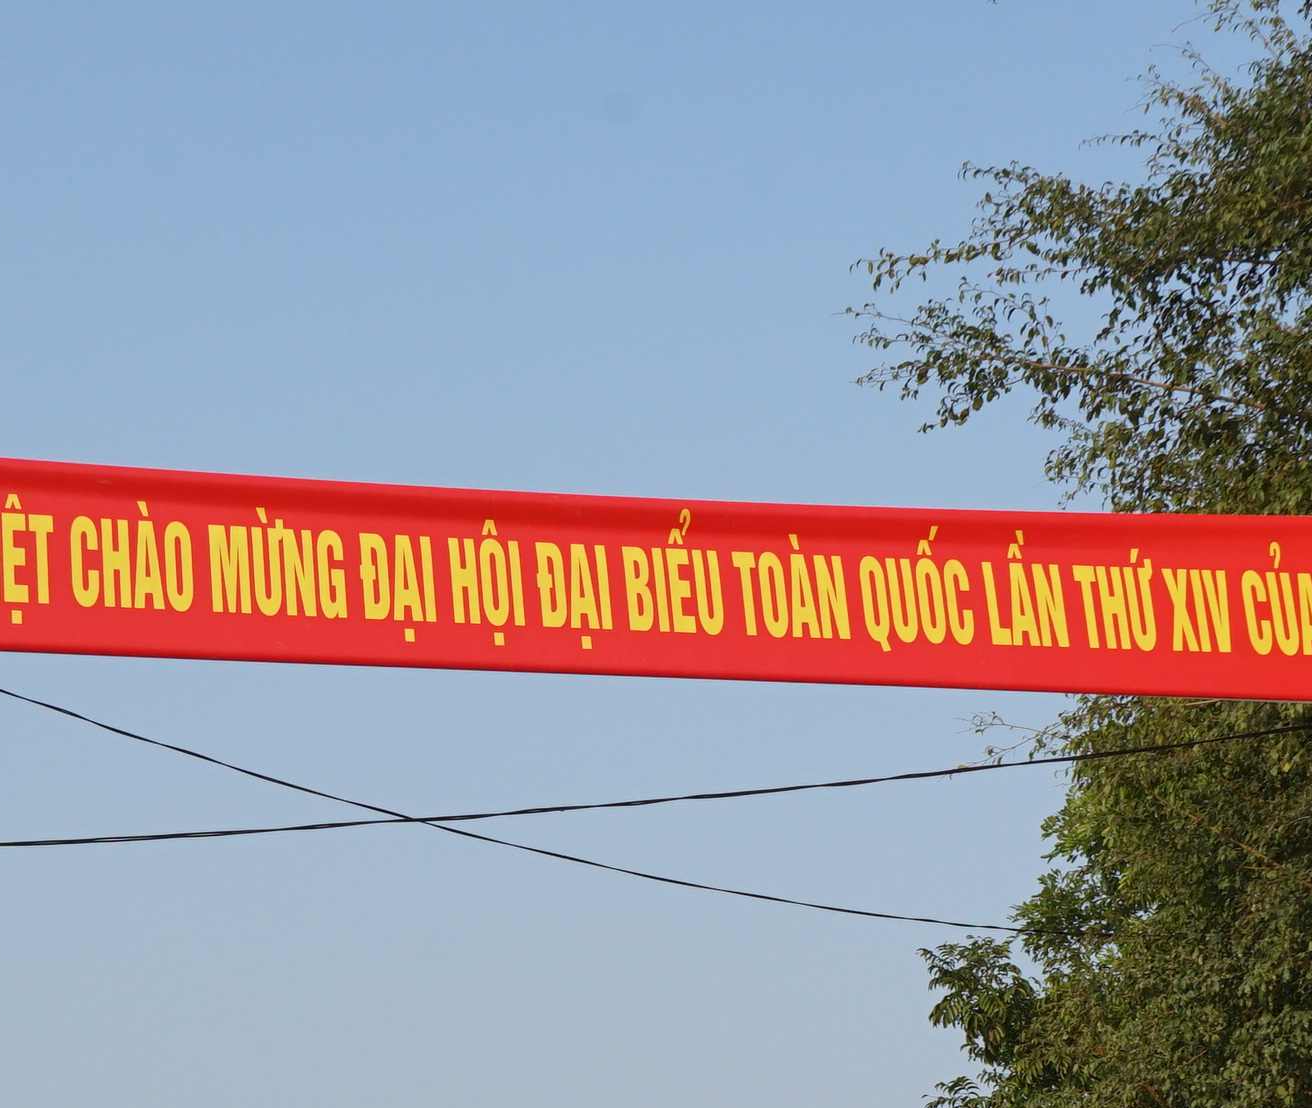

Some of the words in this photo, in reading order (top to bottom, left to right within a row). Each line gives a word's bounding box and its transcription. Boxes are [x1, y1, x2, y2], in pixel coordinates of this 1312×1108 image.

[70, 500, 194, 611] CHÀO
[208, 507, 347, 618] MỪNG
[359, 532, 437, 643] ĐẠI
[448, 519, 526, 646] HỘI
[535, 541, 614, 650] ĐẠI
[626, 508, 725, 636] BIỂU
[731, 521, 846, 640] TOÀN
[859, 525, 974, 652] QUỐC
[981, 529, 1071, 648] LẦN
[1072, 547, 1156, 652] THỨ
[1162, 568, 1233, 654] XIV
